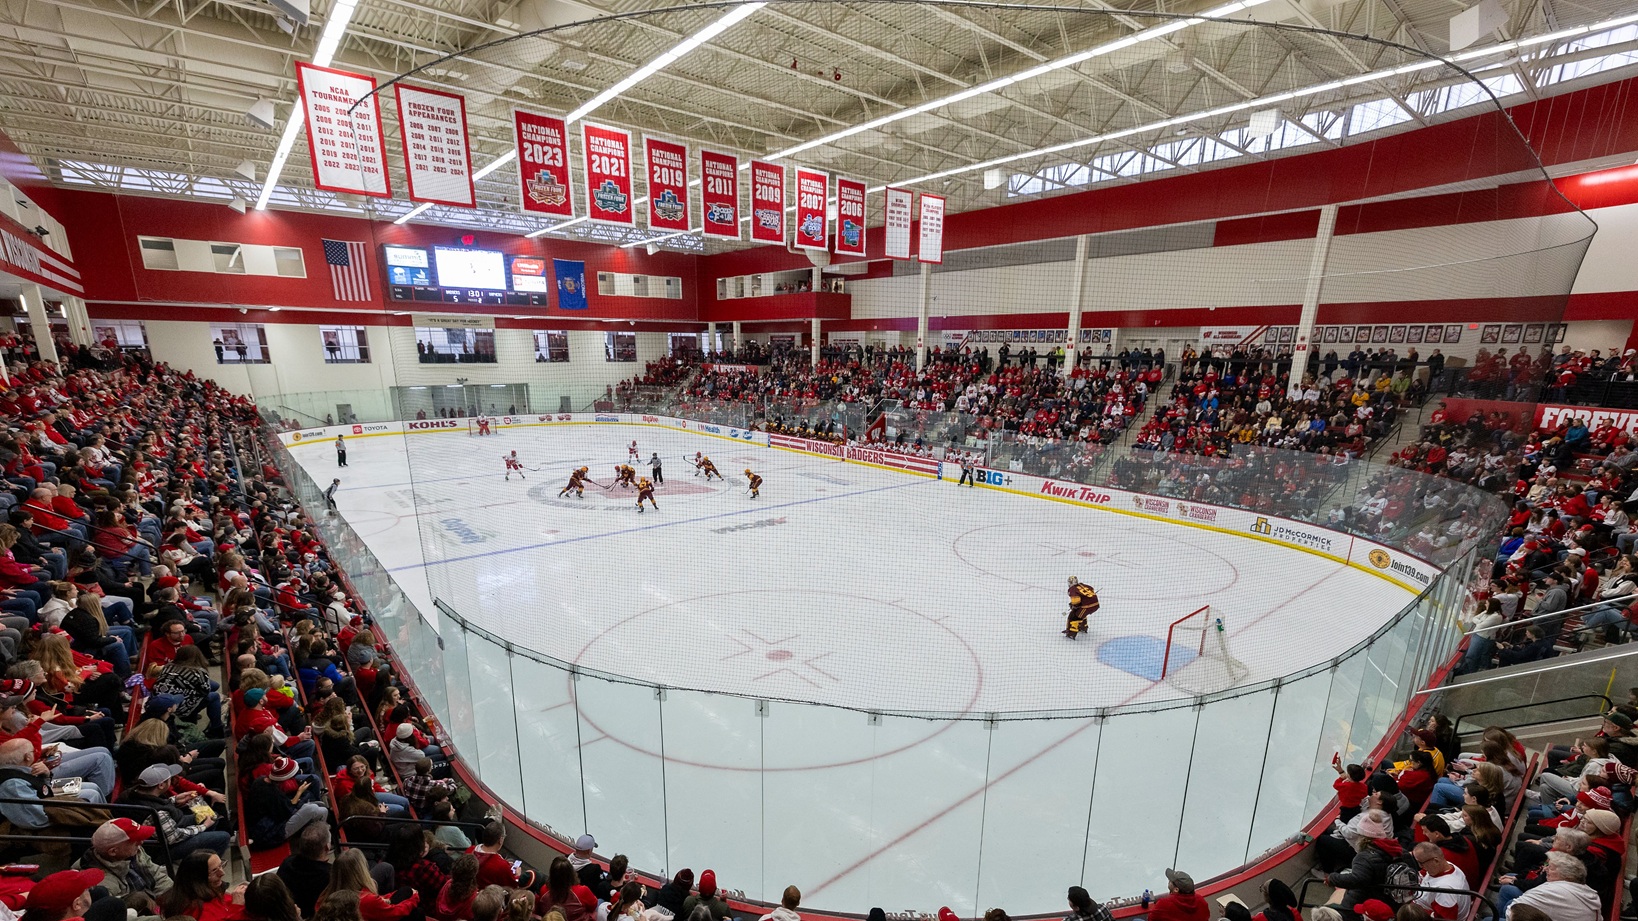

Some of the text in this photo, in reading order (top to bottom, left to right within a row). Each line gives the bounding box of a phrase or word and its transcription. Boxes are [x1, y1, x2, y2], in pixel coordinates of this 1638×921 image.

[330, 86, 349, 96] NCAA
[312, 90, 368, 108] TOURNAMENTS
[408, 102, 455, 116] FROZEN FOUR
[355, 112, 370, 120] 2007
[409, 110, 456, 124] APPEARANCES
[357, 122, 371, 131] 2011
[521, 122, 560, 137] NATIONAL
[318, 127, 373, 142] 2012 2014 2015
[522, 132, 561, 145] CHAMPIONS
[320, 138, 335, 146] 2016
[340, 141, 355, 150] 2017
[447, 138, 460, 146] 2012
[590, 136, 624, 150] NATIONAL
[523, 142, 563, 167] 2023
[590, 144, 624, 157] CHAMPIONS
[652, 148, 682, 162] NATIONAL
[342, 152, 357, 160] 2020
[362, 156, 376, 164] 2021
[652, 156, 682, 169] CHAMPIONS
[324, 160, 340, 168] 2022
[364, 166, 378, 174] 2024
[591, 154, 626, 177] 2021
[705, 160, 733, 171] NATIONAL
[654, 165, 683, 187] 2019
[706, 168, 733, 178] CHAMPIONS
[756, 169, 780, 179] NATIONAL
[708, 177, 733, 196] 2011
[756, 176, 780, 186] CHAMPIONS
[801, 178, 823, 189] NATIONAL
[756, 184, 780, 203] 2009
[801, 185, 823, 195] CHAMPIONS
[842, 186, 862, 197] NATIONAL
[801, 192, 823, 210] 2007
[842, 193, 862, 202] CHAMPIONS
[841, 200, 862, 217] 2006
[409, 420, 457, 429] KOHL'S
[806, 441, 884, 465] WISCONSIN BADGERS
[1144, 504, 1169, 514] CRANBERRIES
[1145, 498, 1169, 508] WISCONSIN
[1189, 506, 1217, 516] WISCONSIN
[1189, 512, 1216, 522] CRANBERRIES
[1273, 533, 1330, 551] PROPERTIES
[1391, 560, 1429, 584] Join139.com
